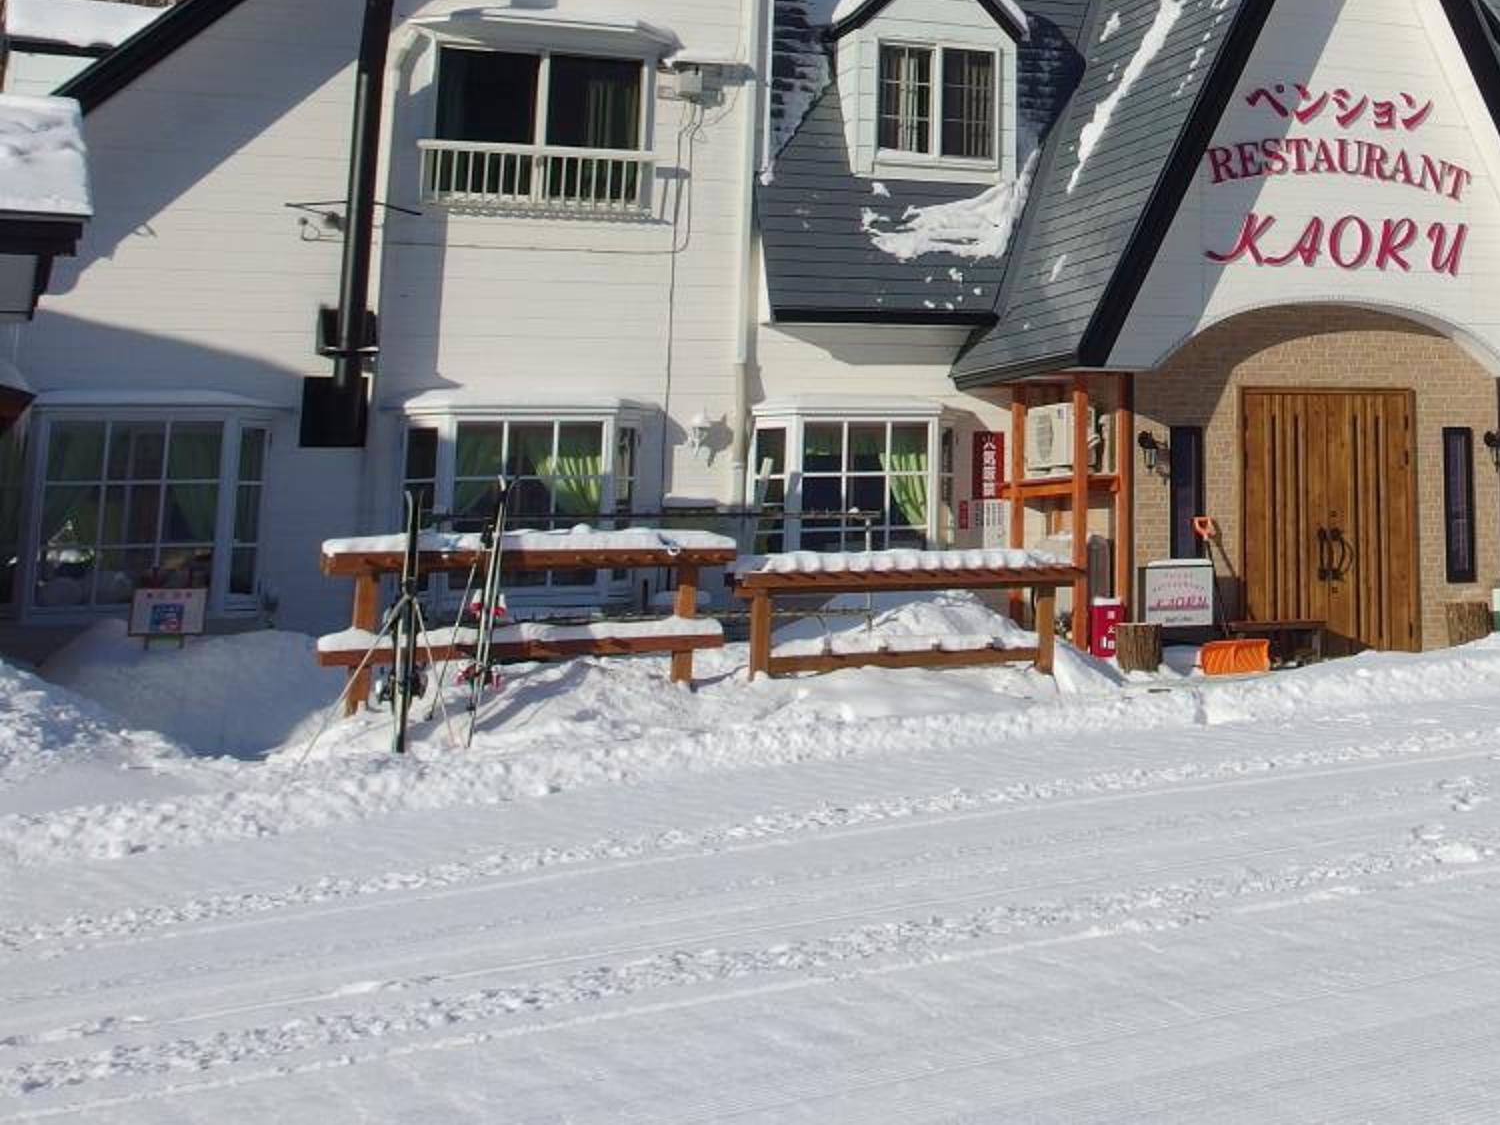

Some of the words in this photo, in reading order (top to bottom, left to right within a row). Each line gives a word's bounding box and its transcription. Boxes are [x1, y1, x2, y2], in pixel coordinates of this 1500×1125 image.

[1246, 83, 1434, 130] ペンション
[1207, 138, 1472, 202] RESTAURANT
[1204, 213, 1469, 276] KAORU
